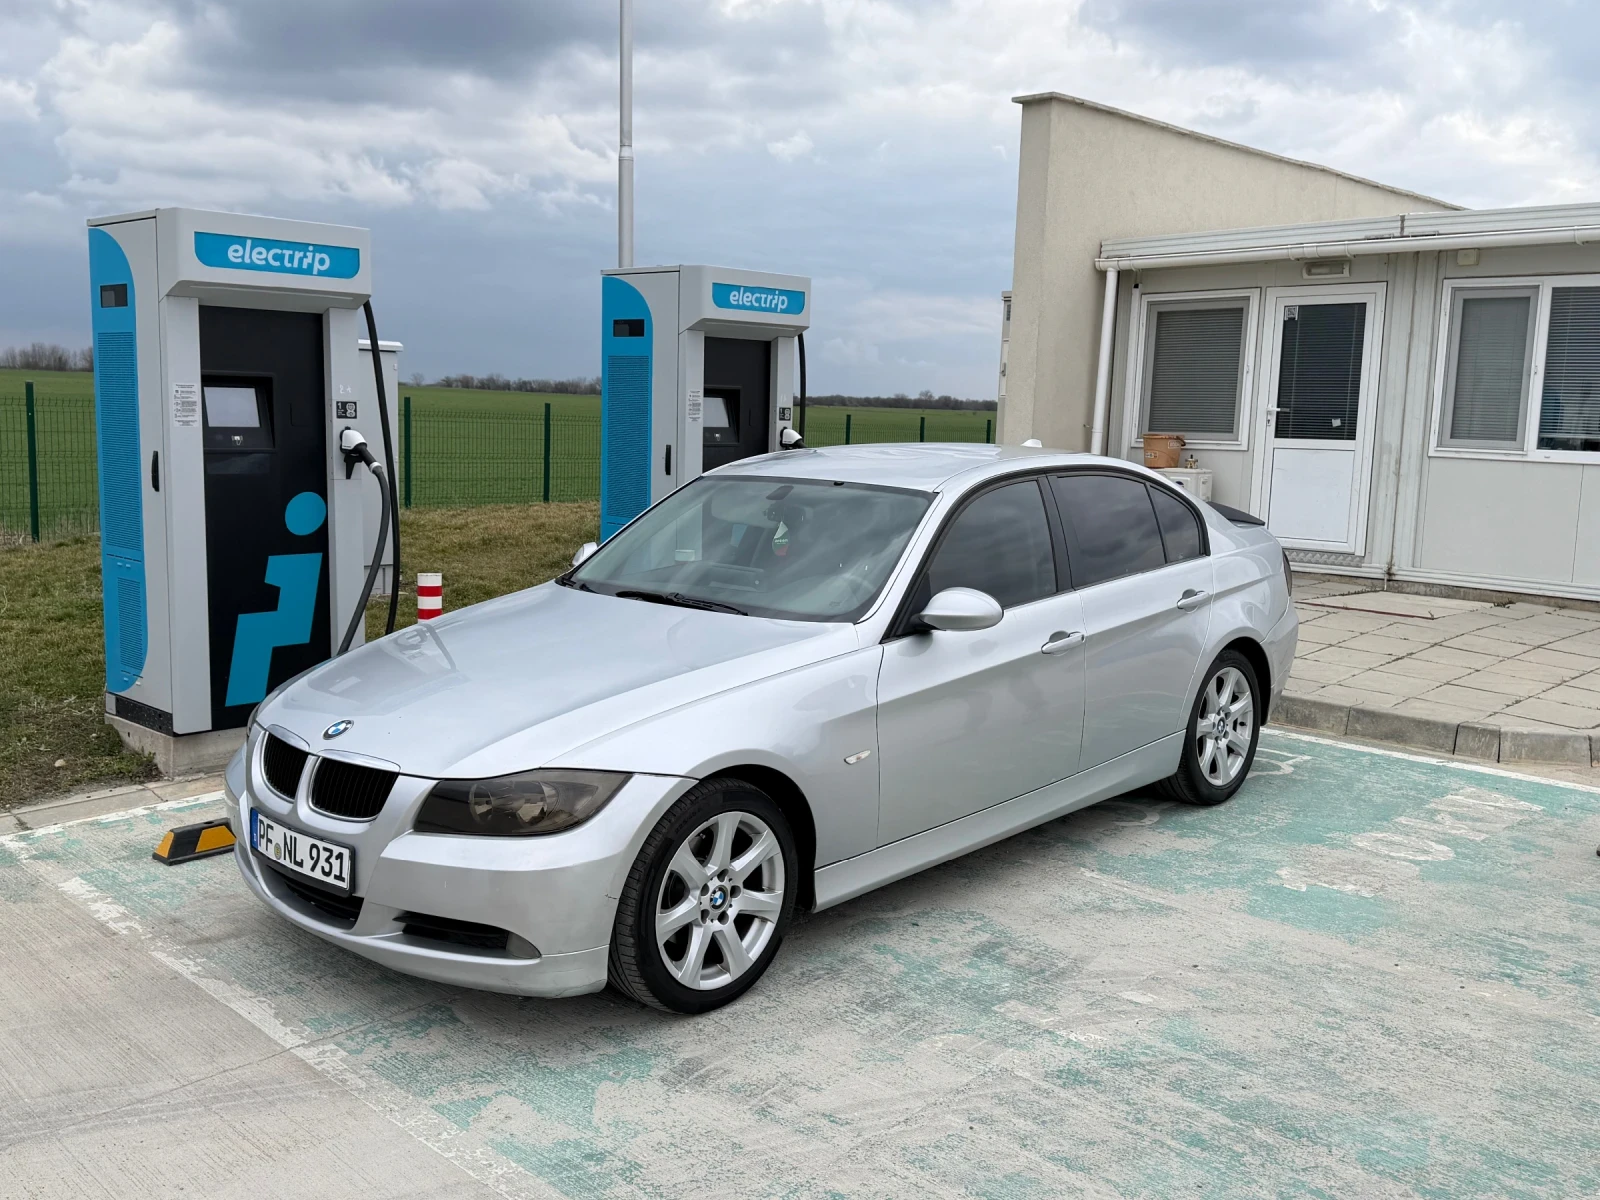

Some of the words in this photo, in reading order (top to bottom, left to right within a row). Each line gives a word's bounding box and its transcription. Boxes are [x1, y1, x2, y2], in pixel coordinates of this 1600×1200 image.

[227, 239, 331, 275] electrip
[729, 286, 788, 313] electrip
[258, 818, 275, 852] PF
[283, 831, 304, 869] NL
[309, 843, 346, 883] 931
